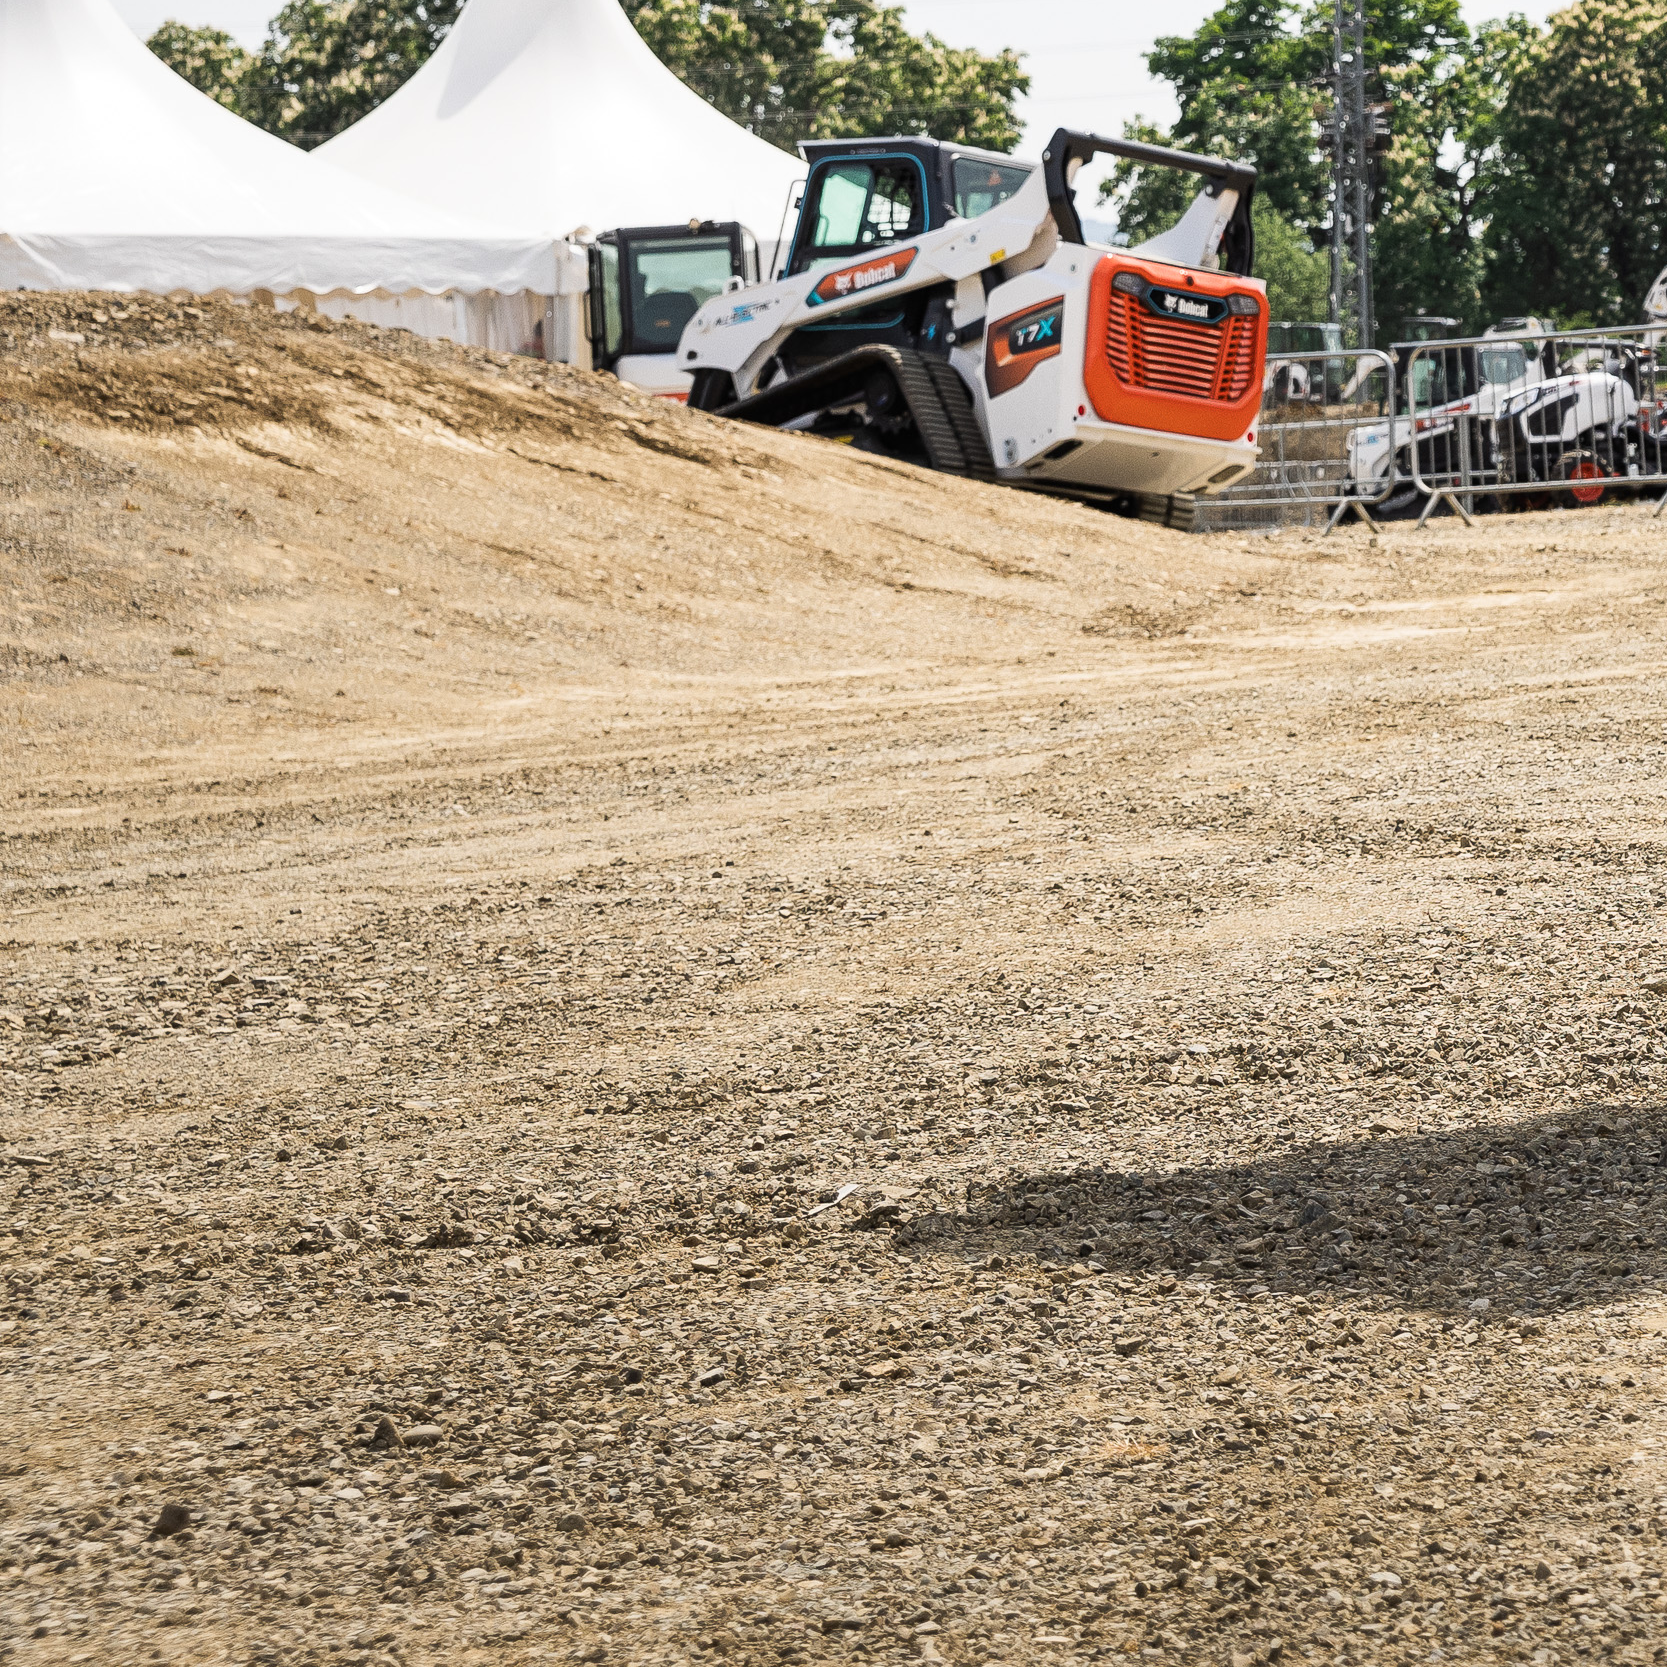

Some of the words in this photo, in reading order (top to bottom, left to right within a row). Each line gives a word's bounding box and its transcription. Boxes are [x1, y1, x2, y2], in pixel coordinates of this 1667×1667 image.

[854, 262, 896, 290] Bobcat
[1177, 298, 1209, 318] Bobcat
[1016, 316, 1056, 347] T7X
